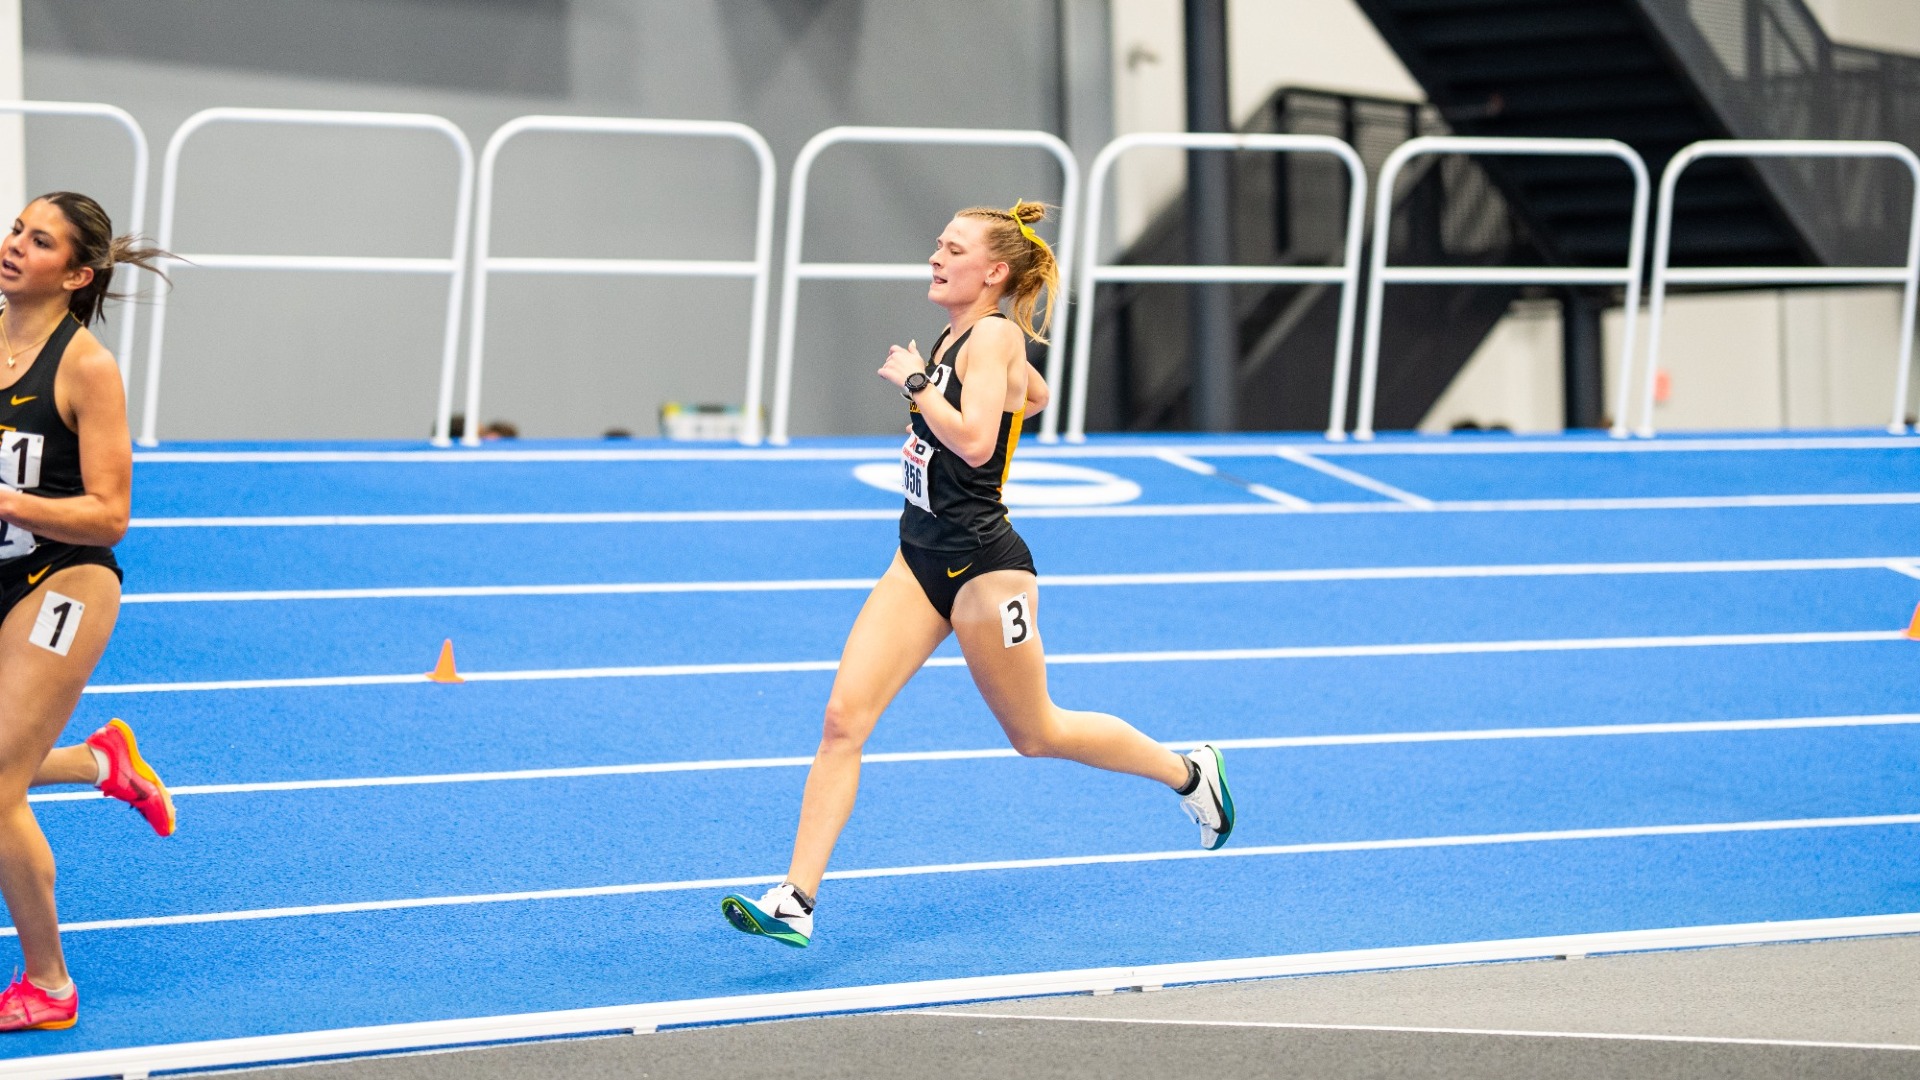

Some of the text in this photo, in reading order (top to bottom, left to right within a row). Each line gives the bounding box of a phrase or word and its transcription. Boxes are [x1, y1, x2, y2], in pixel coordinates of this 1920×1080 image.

[12, 437, 29, 484] 1
[905, 459, 921, 497] 356
[49, 601, 72, 648] 1
[1006, 600, 1027, 643] 3
